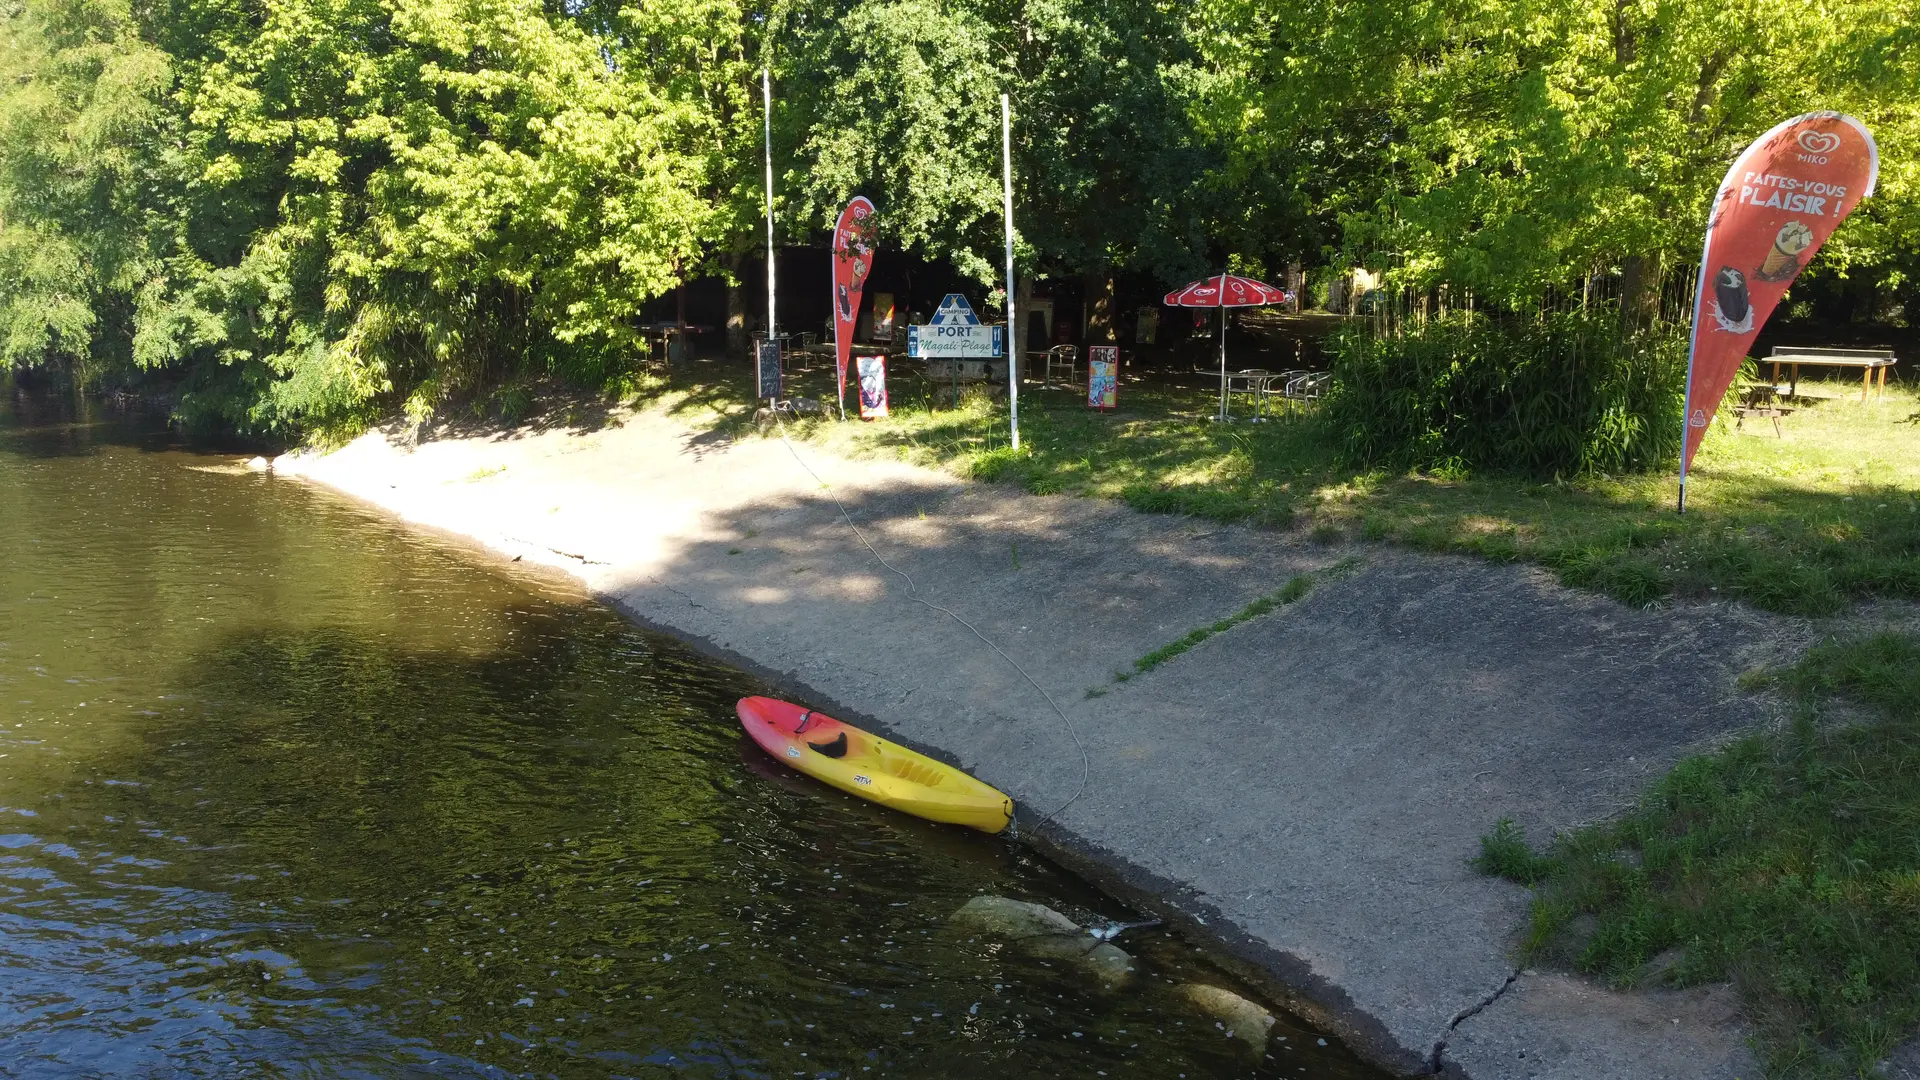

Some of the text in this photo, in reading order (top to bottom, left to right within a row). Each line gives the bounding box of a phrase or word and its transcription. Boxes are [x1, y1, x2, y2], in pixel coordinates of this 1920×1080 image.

[1798, 153, 1828, 165] MIKO
[1744, 171, 1847, 198] FAITES-VOUS
[1739, 185, 1827, 216] PLAISIR
[937, 326, 973, 337] PORT
